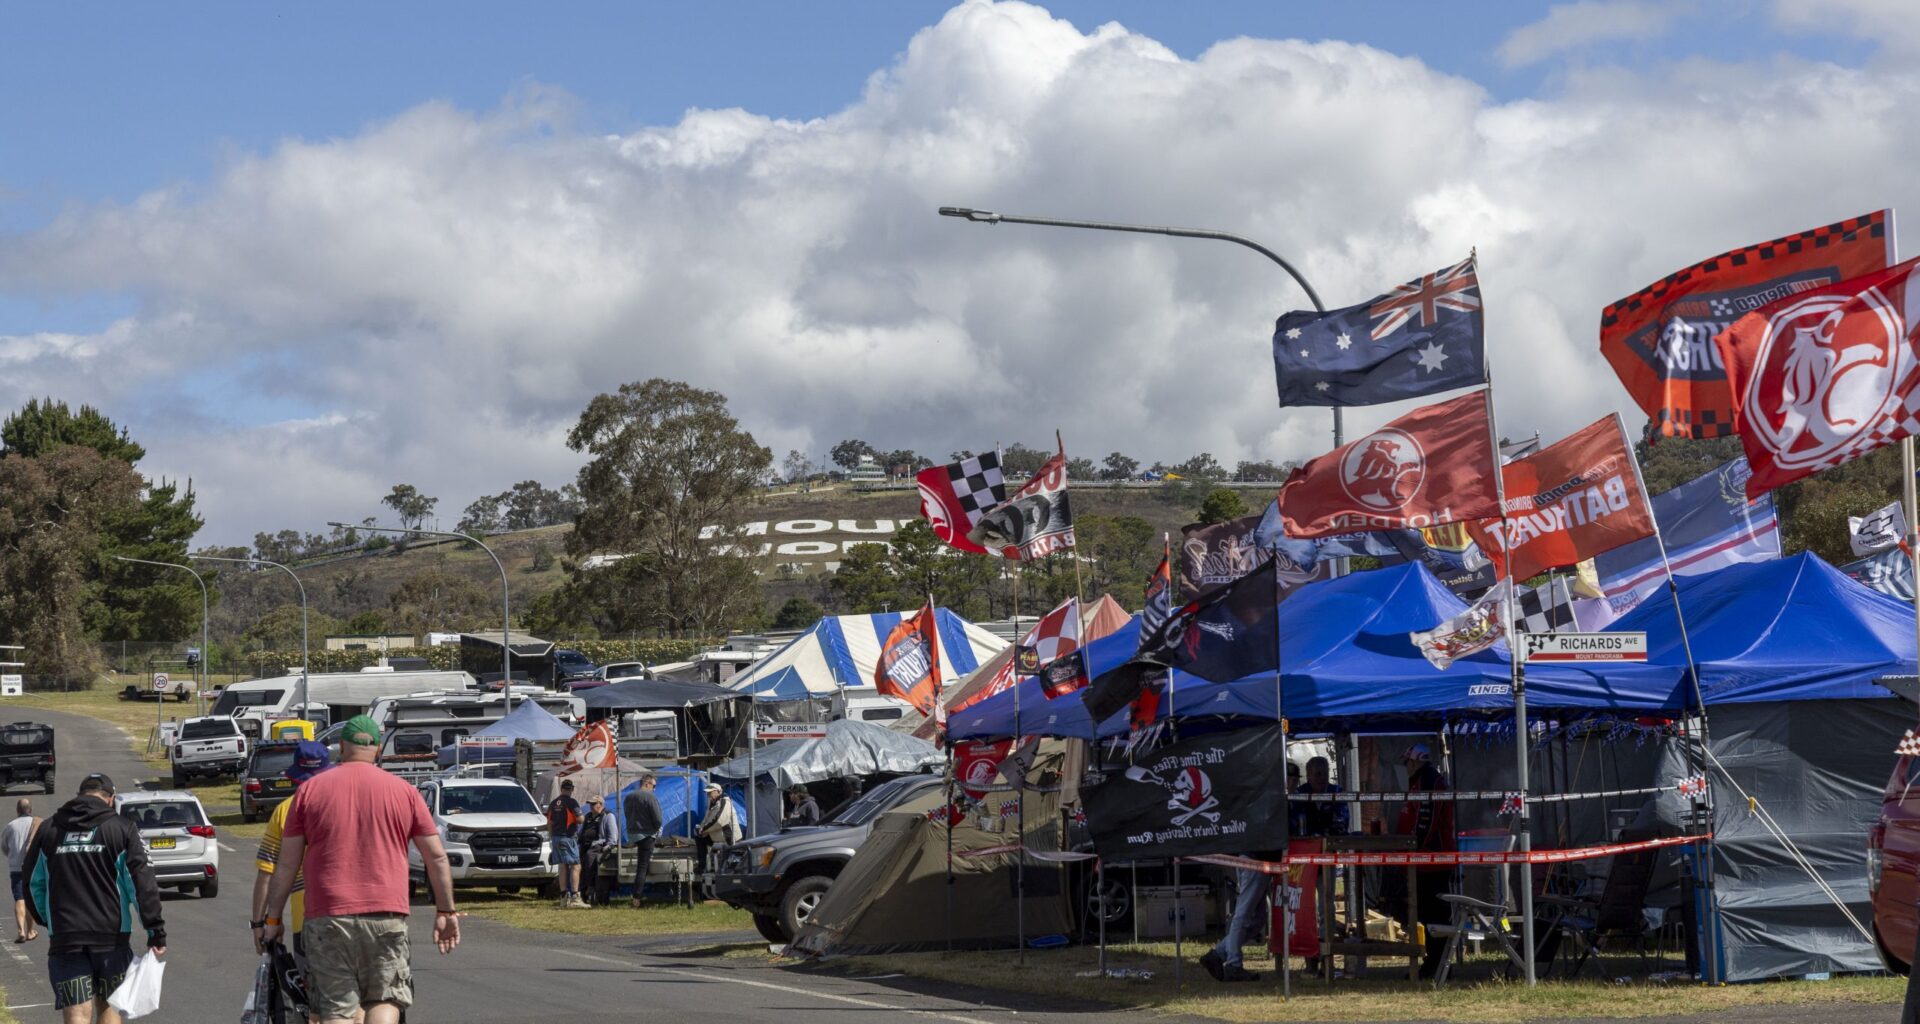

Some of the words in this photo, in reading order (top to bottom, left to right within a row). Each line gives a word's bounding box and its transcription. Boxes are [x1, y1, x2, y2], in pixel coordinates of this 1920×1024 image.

[1560, 638, 1622, 650] RICHARDS
[1624, 637, 1638, 645] AVE
[157, 678, 166, 686] 20
[1469, 684, 1509, 695] KINGS
[777, 725, 808, 733] PERKINS
